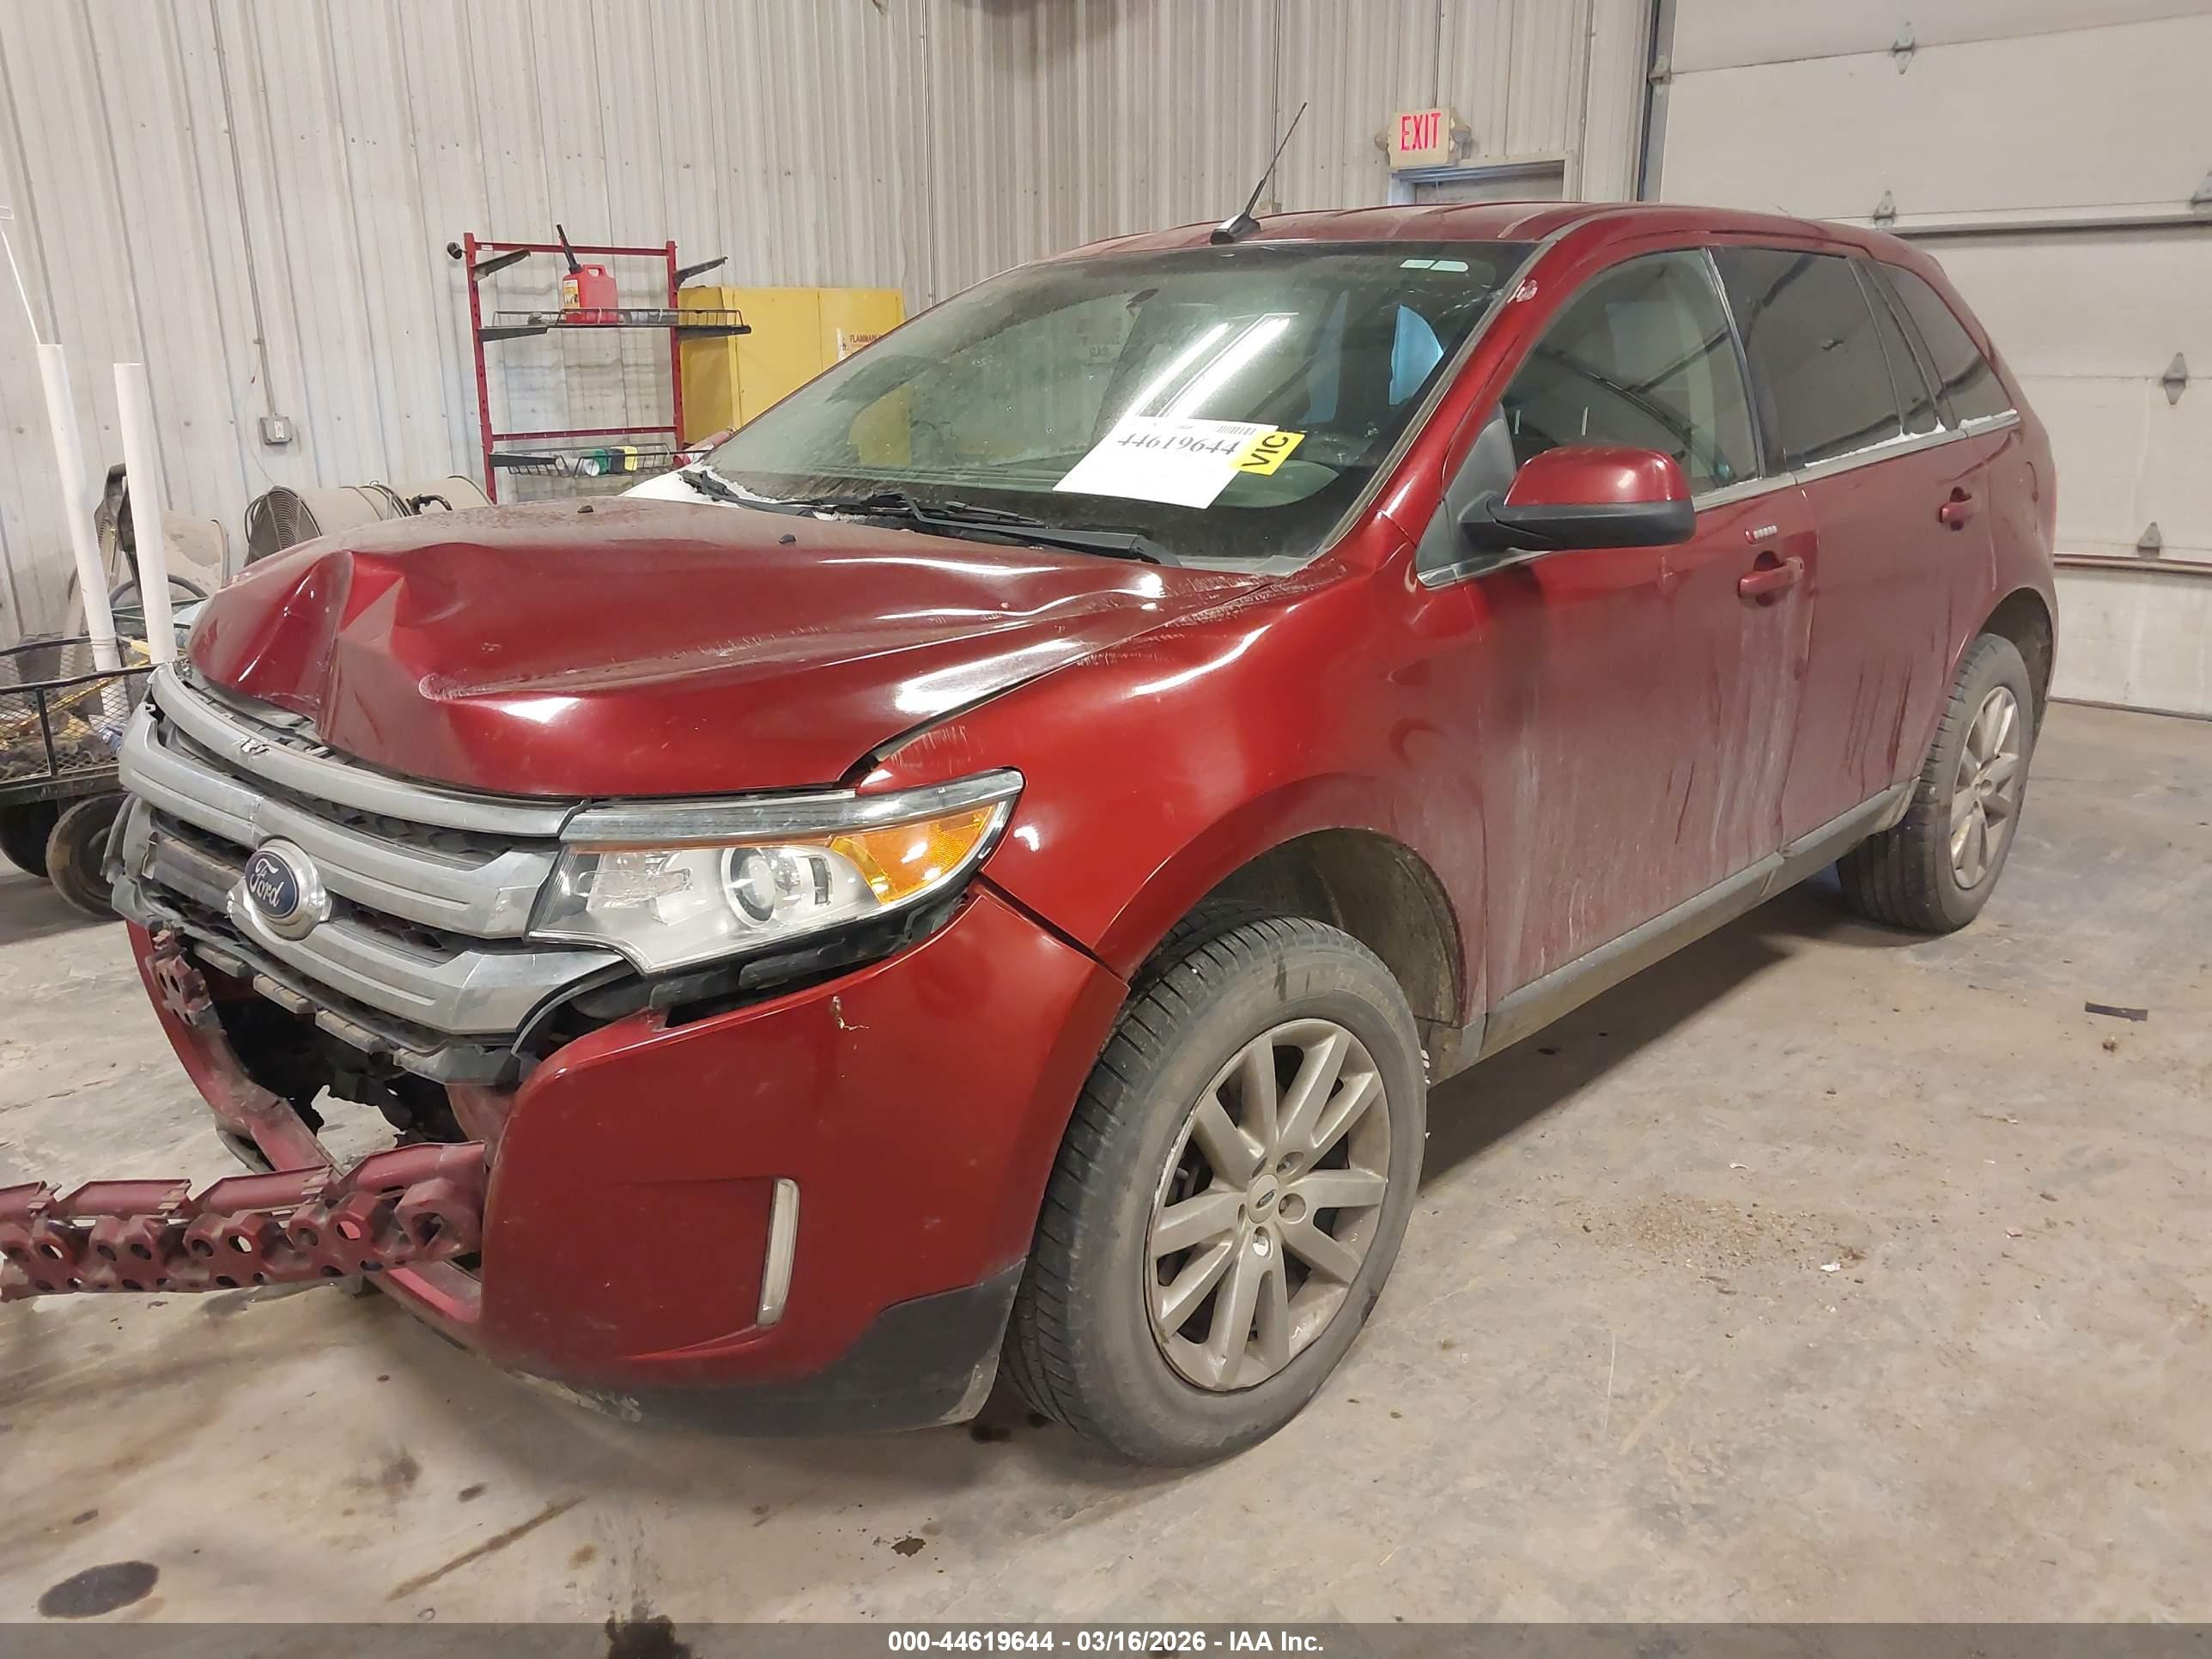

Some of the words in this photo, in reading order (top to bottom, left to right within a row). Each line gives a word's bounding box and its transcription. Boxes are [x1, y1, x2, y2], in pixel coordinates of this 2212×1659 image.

[1401, 112, 1442, 151] EXIT
[1116, 432, 1241, 455] 44619644
[1241, 434, 1290, 467] VIC
[249, 858, 285, 908] Ford
